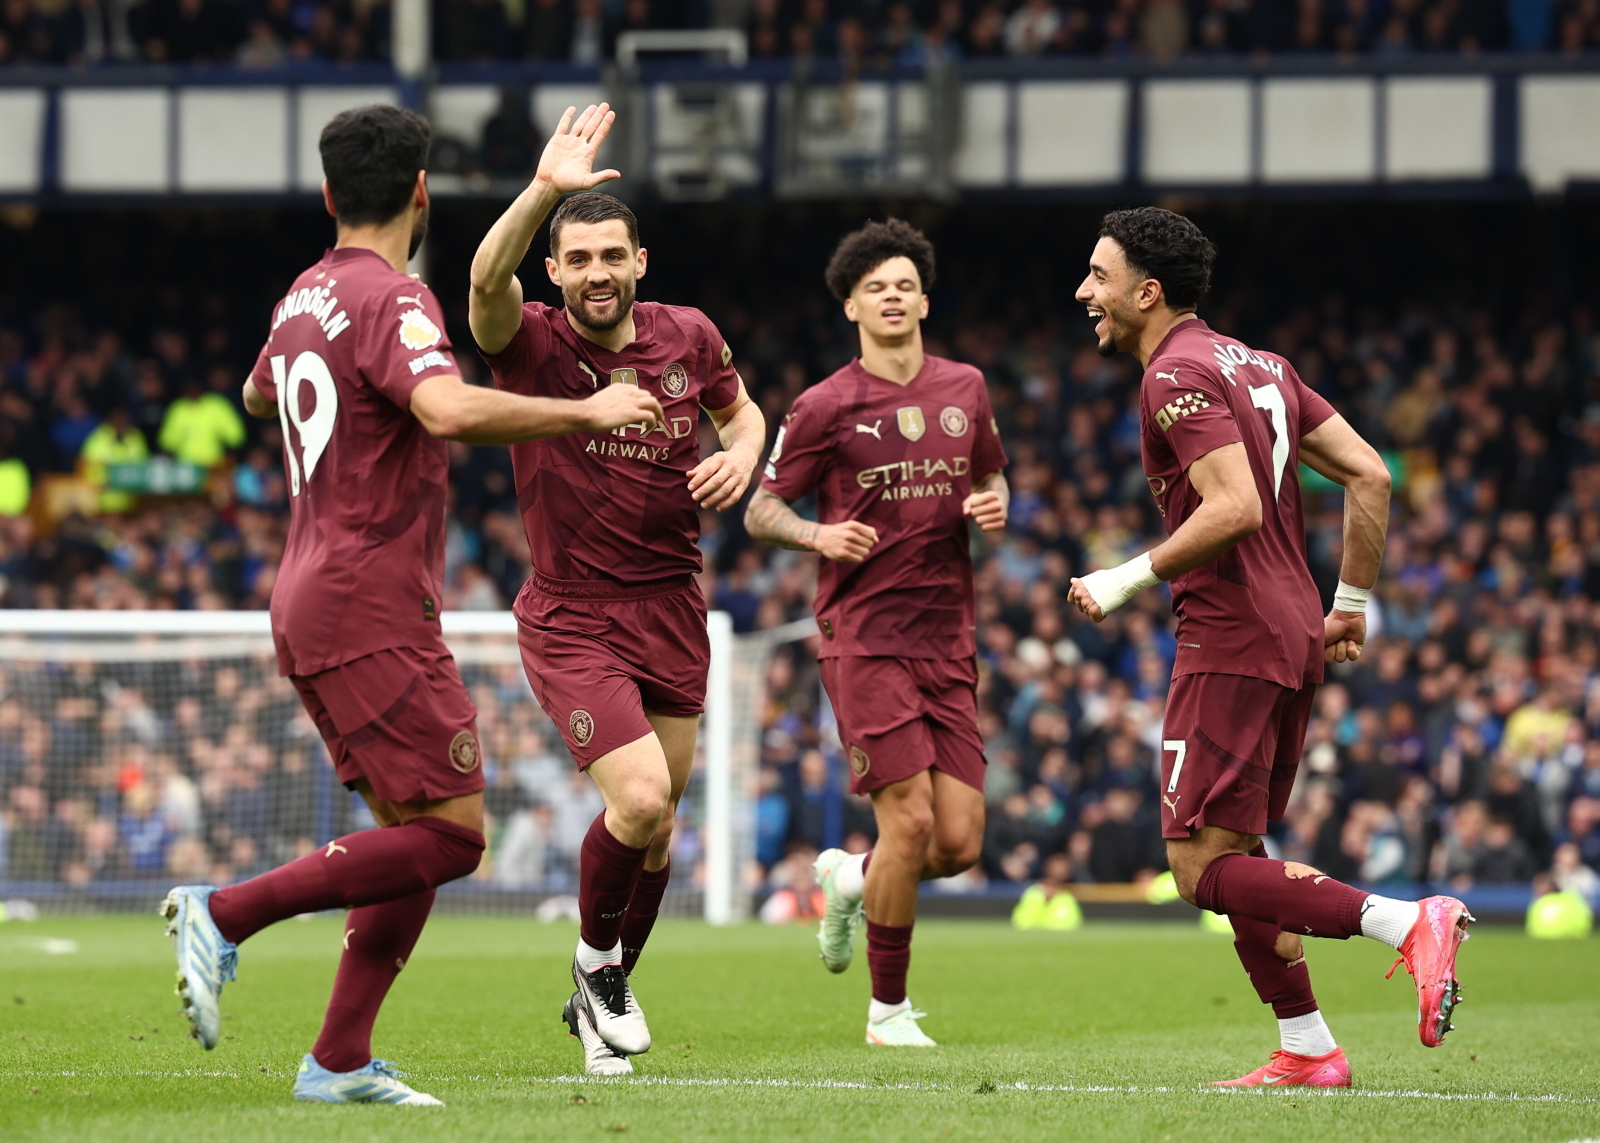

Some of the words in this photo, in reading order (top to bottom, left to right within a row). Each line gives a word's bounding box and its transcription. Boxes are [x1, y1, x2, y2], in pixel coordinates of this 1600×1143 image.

[268, 278, 351, 341] NDOĞAN
[270, 351, 338, 497] 19
[611, 416, 692, 439] HAD
[1247, 383, 1290, 504] 7
[585, 439, 670, 460] AIRWAYS
[856, 456, 970, 489] ETIHAD
[881, 482, 953, 501] AIRWAYS
[1163, 740, 1186, 793] 7
